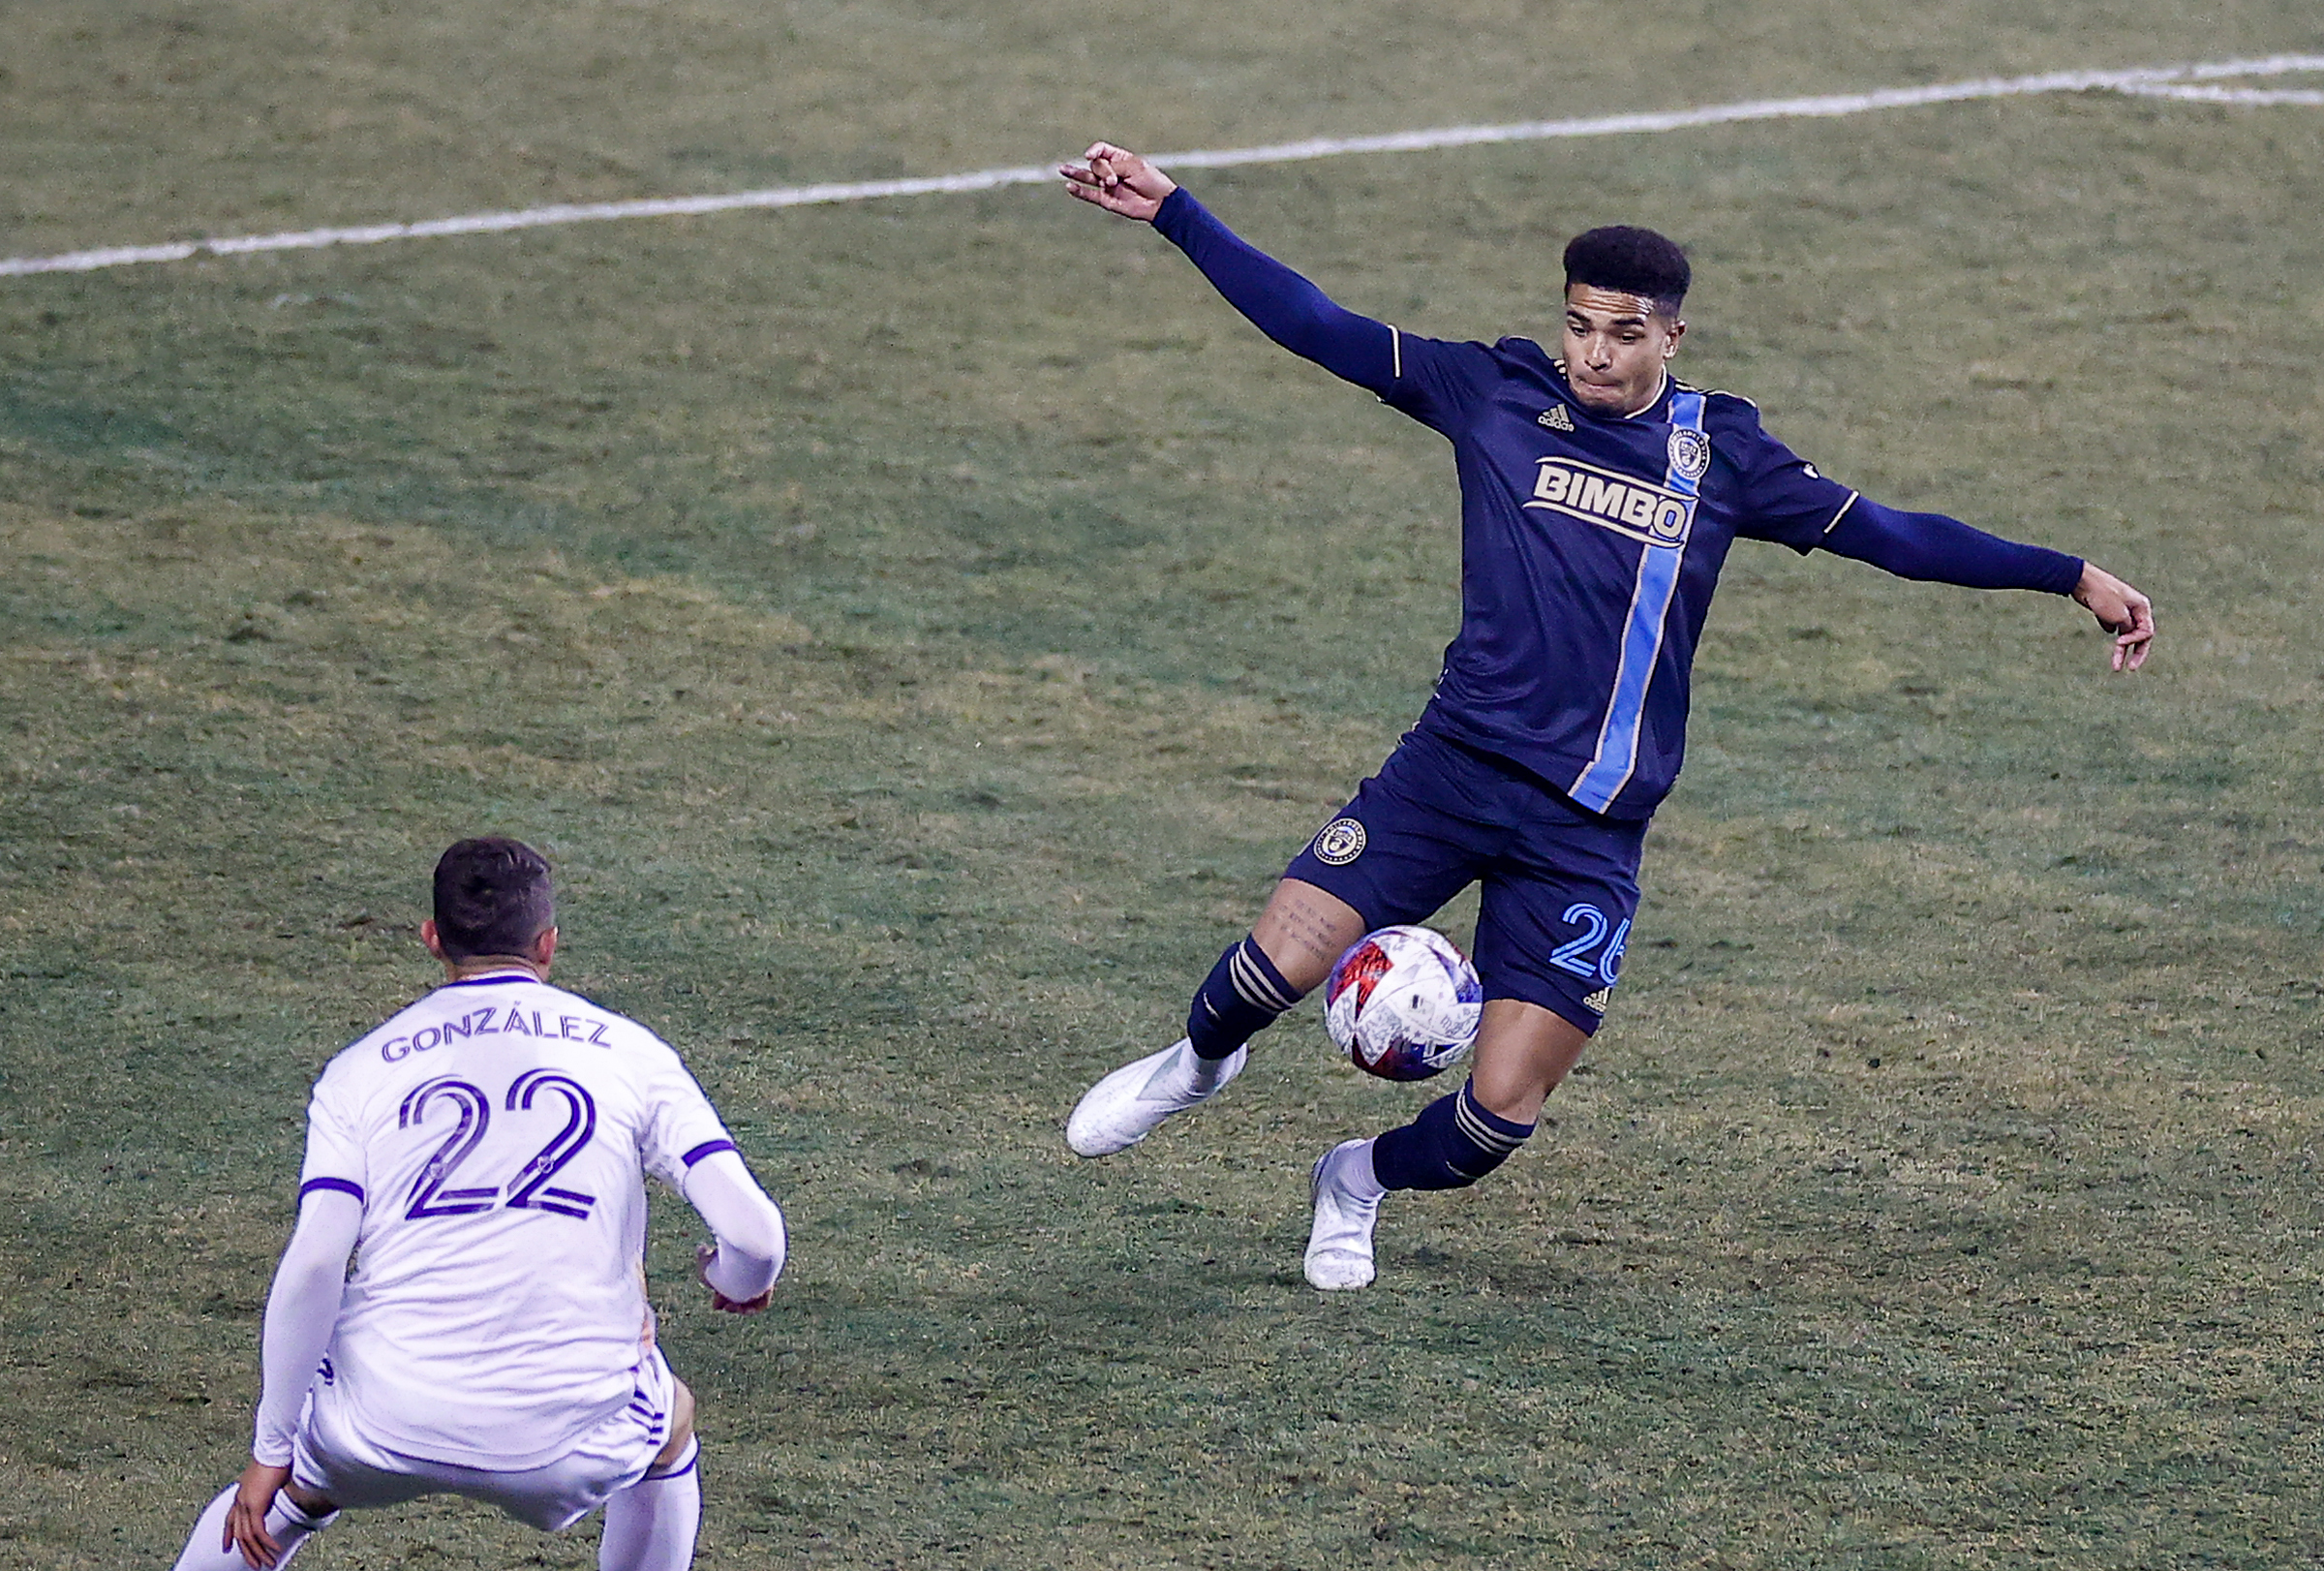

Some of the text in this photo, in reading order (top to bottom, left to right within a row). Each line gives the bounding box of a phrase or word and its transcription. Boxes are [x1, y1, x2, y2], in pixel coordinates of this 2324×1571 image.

[1538, 416, 1575, 432] adidas
[1534, 464, 1687, 539] BIMBO
[382, 1001, 612, 1063] GONZÁLEZ
[398, 1067, 597, 1220] 22
